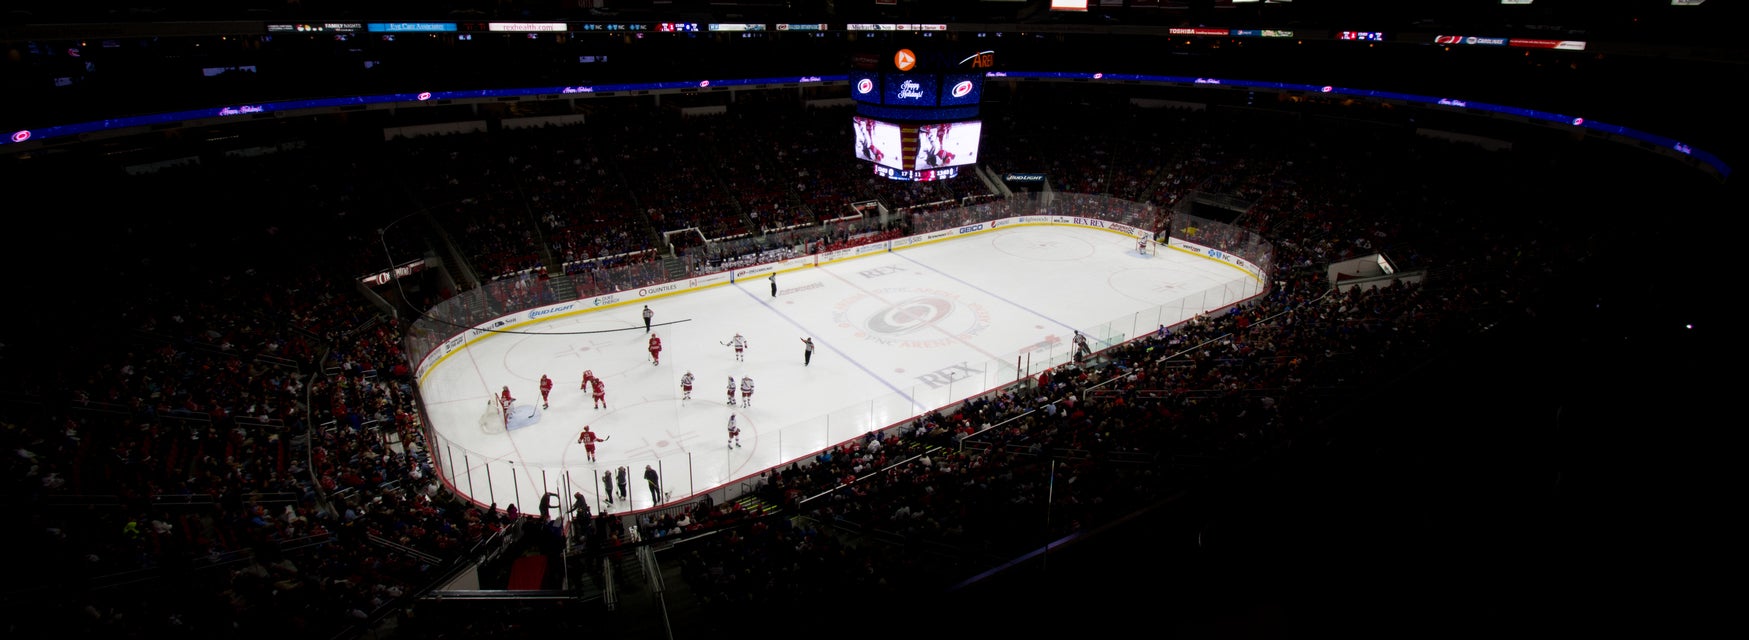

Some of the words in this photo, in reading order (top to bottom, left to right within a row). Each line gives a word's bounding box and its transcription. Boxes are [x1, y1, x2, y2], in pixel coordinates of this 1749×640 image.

[503, 23, 553, 31] rexhealth.com
[1073, 217, 1088, 225] REX
[1090, 219, 1104, 228] REX
[959, 224, 983, 234] GEICO
[1222, 254, 1231, 262] NC
[857, 264, 907, 279] REX
[648, 284, 677, 294] QUINTILES
[602, 297, 620, 305] ENERGY
[530, 308, 550, 319] BUD
[550, 304, 574, 314] LIGHT
[505, 317, 517, 325] Son
[914, 361, 985, 389] REX
